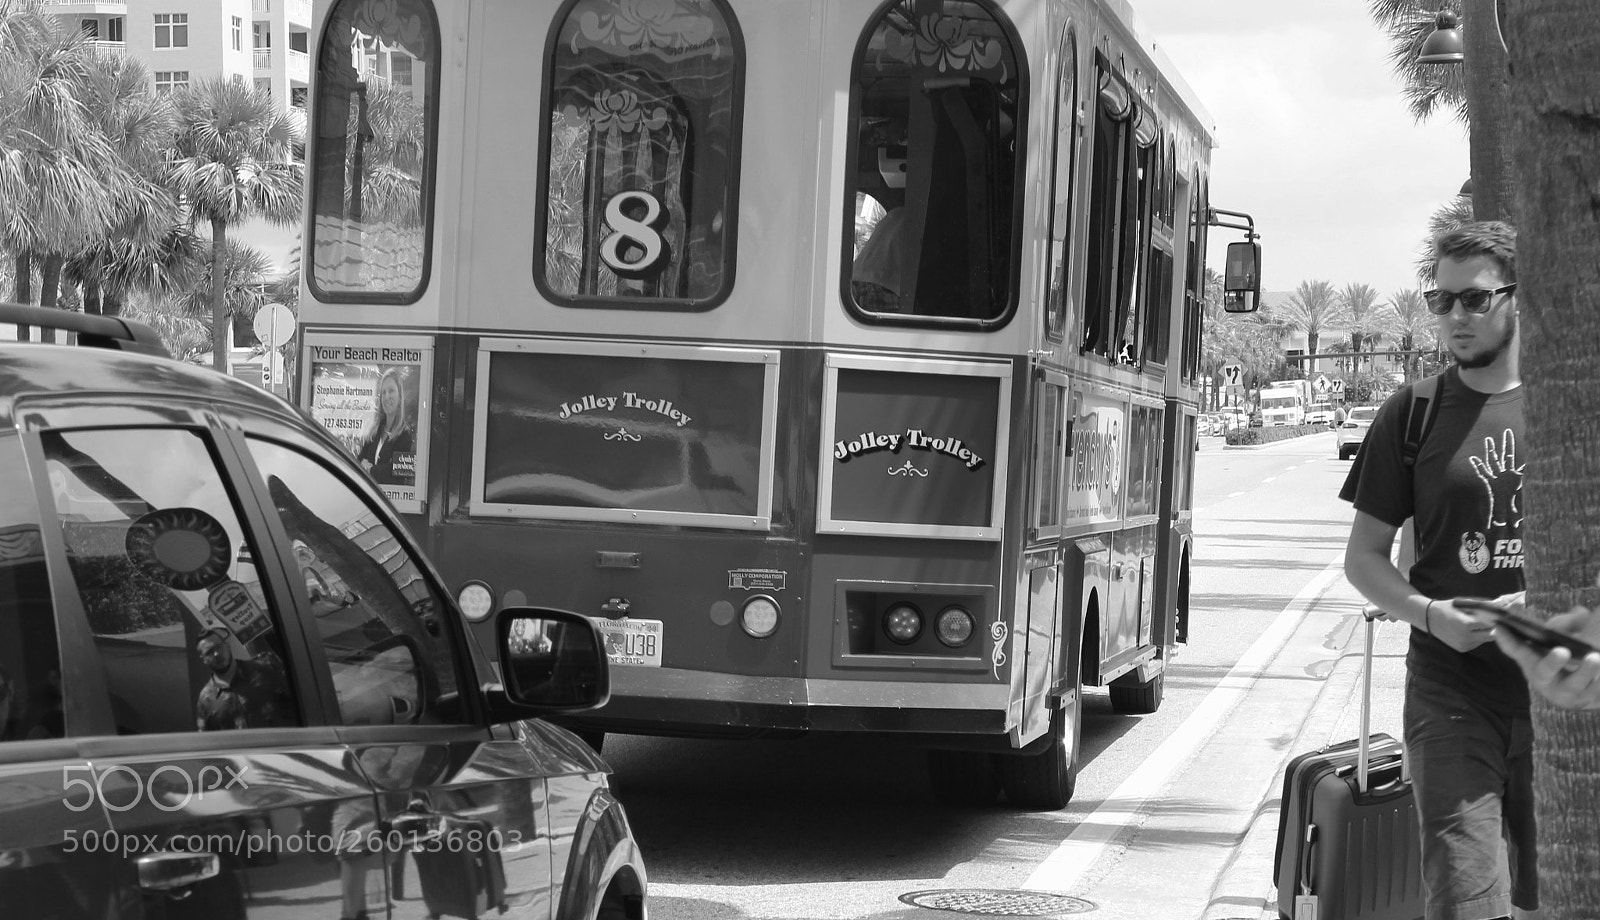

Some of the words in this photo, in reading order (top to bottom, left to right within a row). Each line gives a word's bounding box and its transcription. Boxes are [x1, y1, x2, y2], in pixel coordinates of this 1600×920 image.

[600, 189, 662, 272] 8
[315, 346, 341, 360] Your
[344, 347, 378, 361] Beach
[316, 384, 345, 397] Stephanie
[345, 385, 373, 397] Hartmann
[559, 394, 618, 419] Jolley
[623, 391, 692, 427] Trolley
[323, 418, 363, 430] 727.463.9157
[834, 431, 902, 460] Jolley
[906, 428, 983, 468] Trolley
[625, 633, 656, 656] U38
[621, 657, 642, 665] STATE
